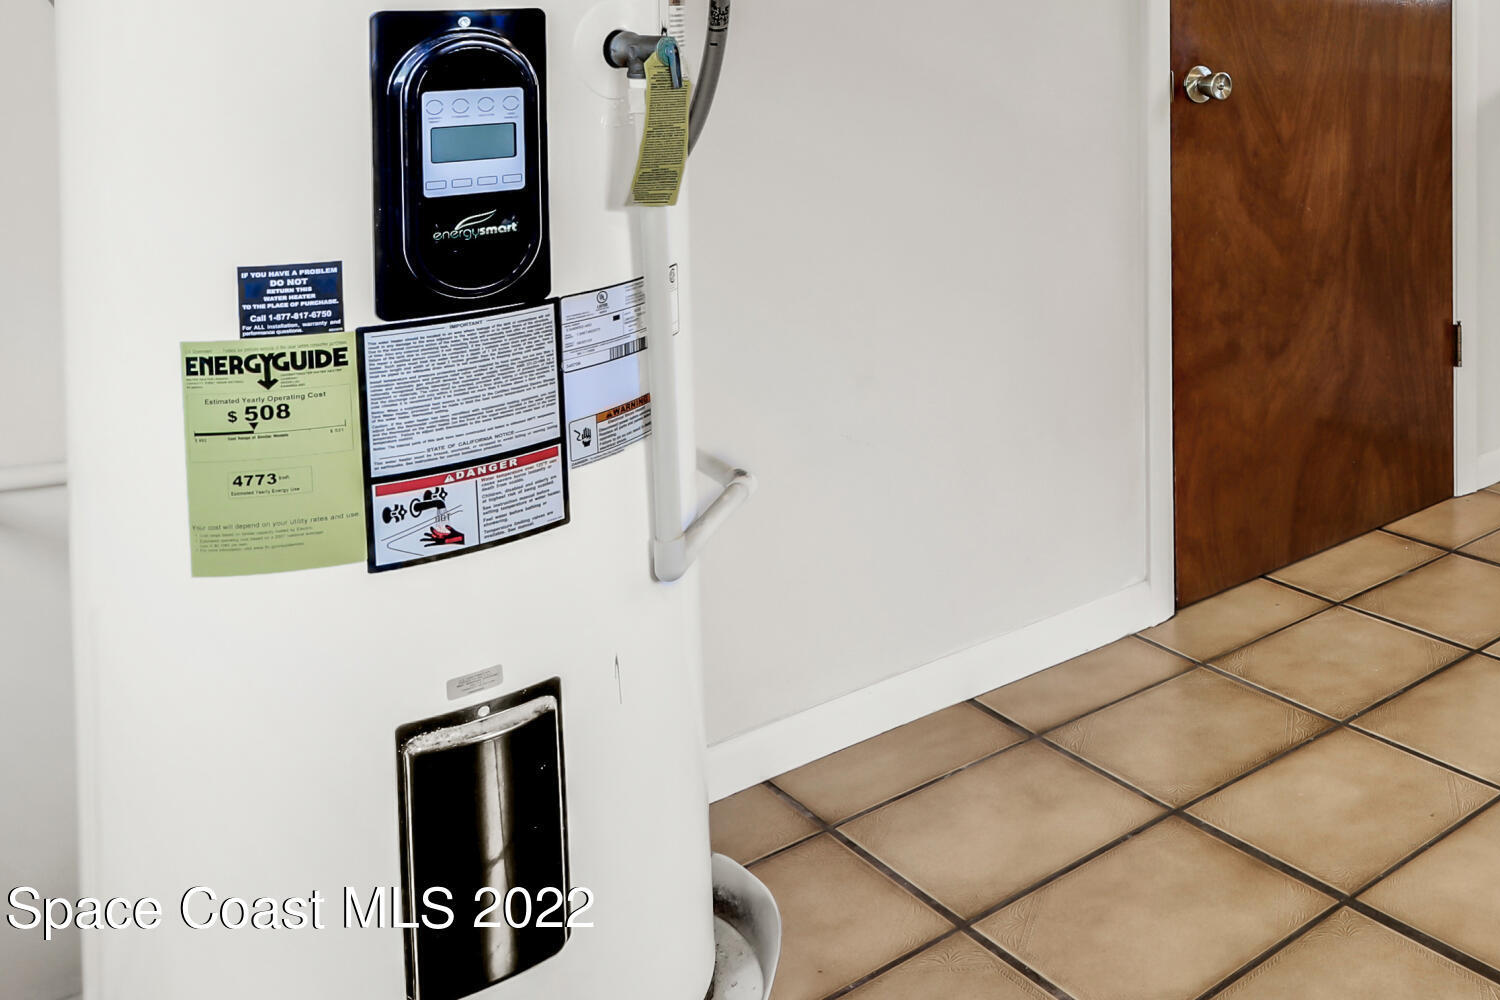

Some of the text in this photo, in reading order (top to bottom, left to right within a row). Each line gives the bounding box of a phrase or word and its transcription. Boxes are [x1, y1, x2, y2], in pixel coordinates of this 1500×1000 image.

[433, 222, 517, 240] energysmart
[299, 267, 337, 275] PROBLEM
[287, 278, 308, 286] NOT
[267, 301, 288, 309] PLACE
[250, 314, 266, 322] Call
[450, 320, 482, 329] IMPORTANT
[185, 347, 348, 377] ENERGYGUIDE
[204, 398, 239, 406] Estimated
[241, 397, 265, 405] Yearly
[267, 393, 305, 402] Operating
[227, 403, 291, 423] $ 508
[458, 435, 492, 446] CALIFORNIA
[455, 458, 518, 480] DANGER
[232, 473, 277, 487] 4773
[235, 522, 260, 530] depend
[290, 517, 308, 525] utility
